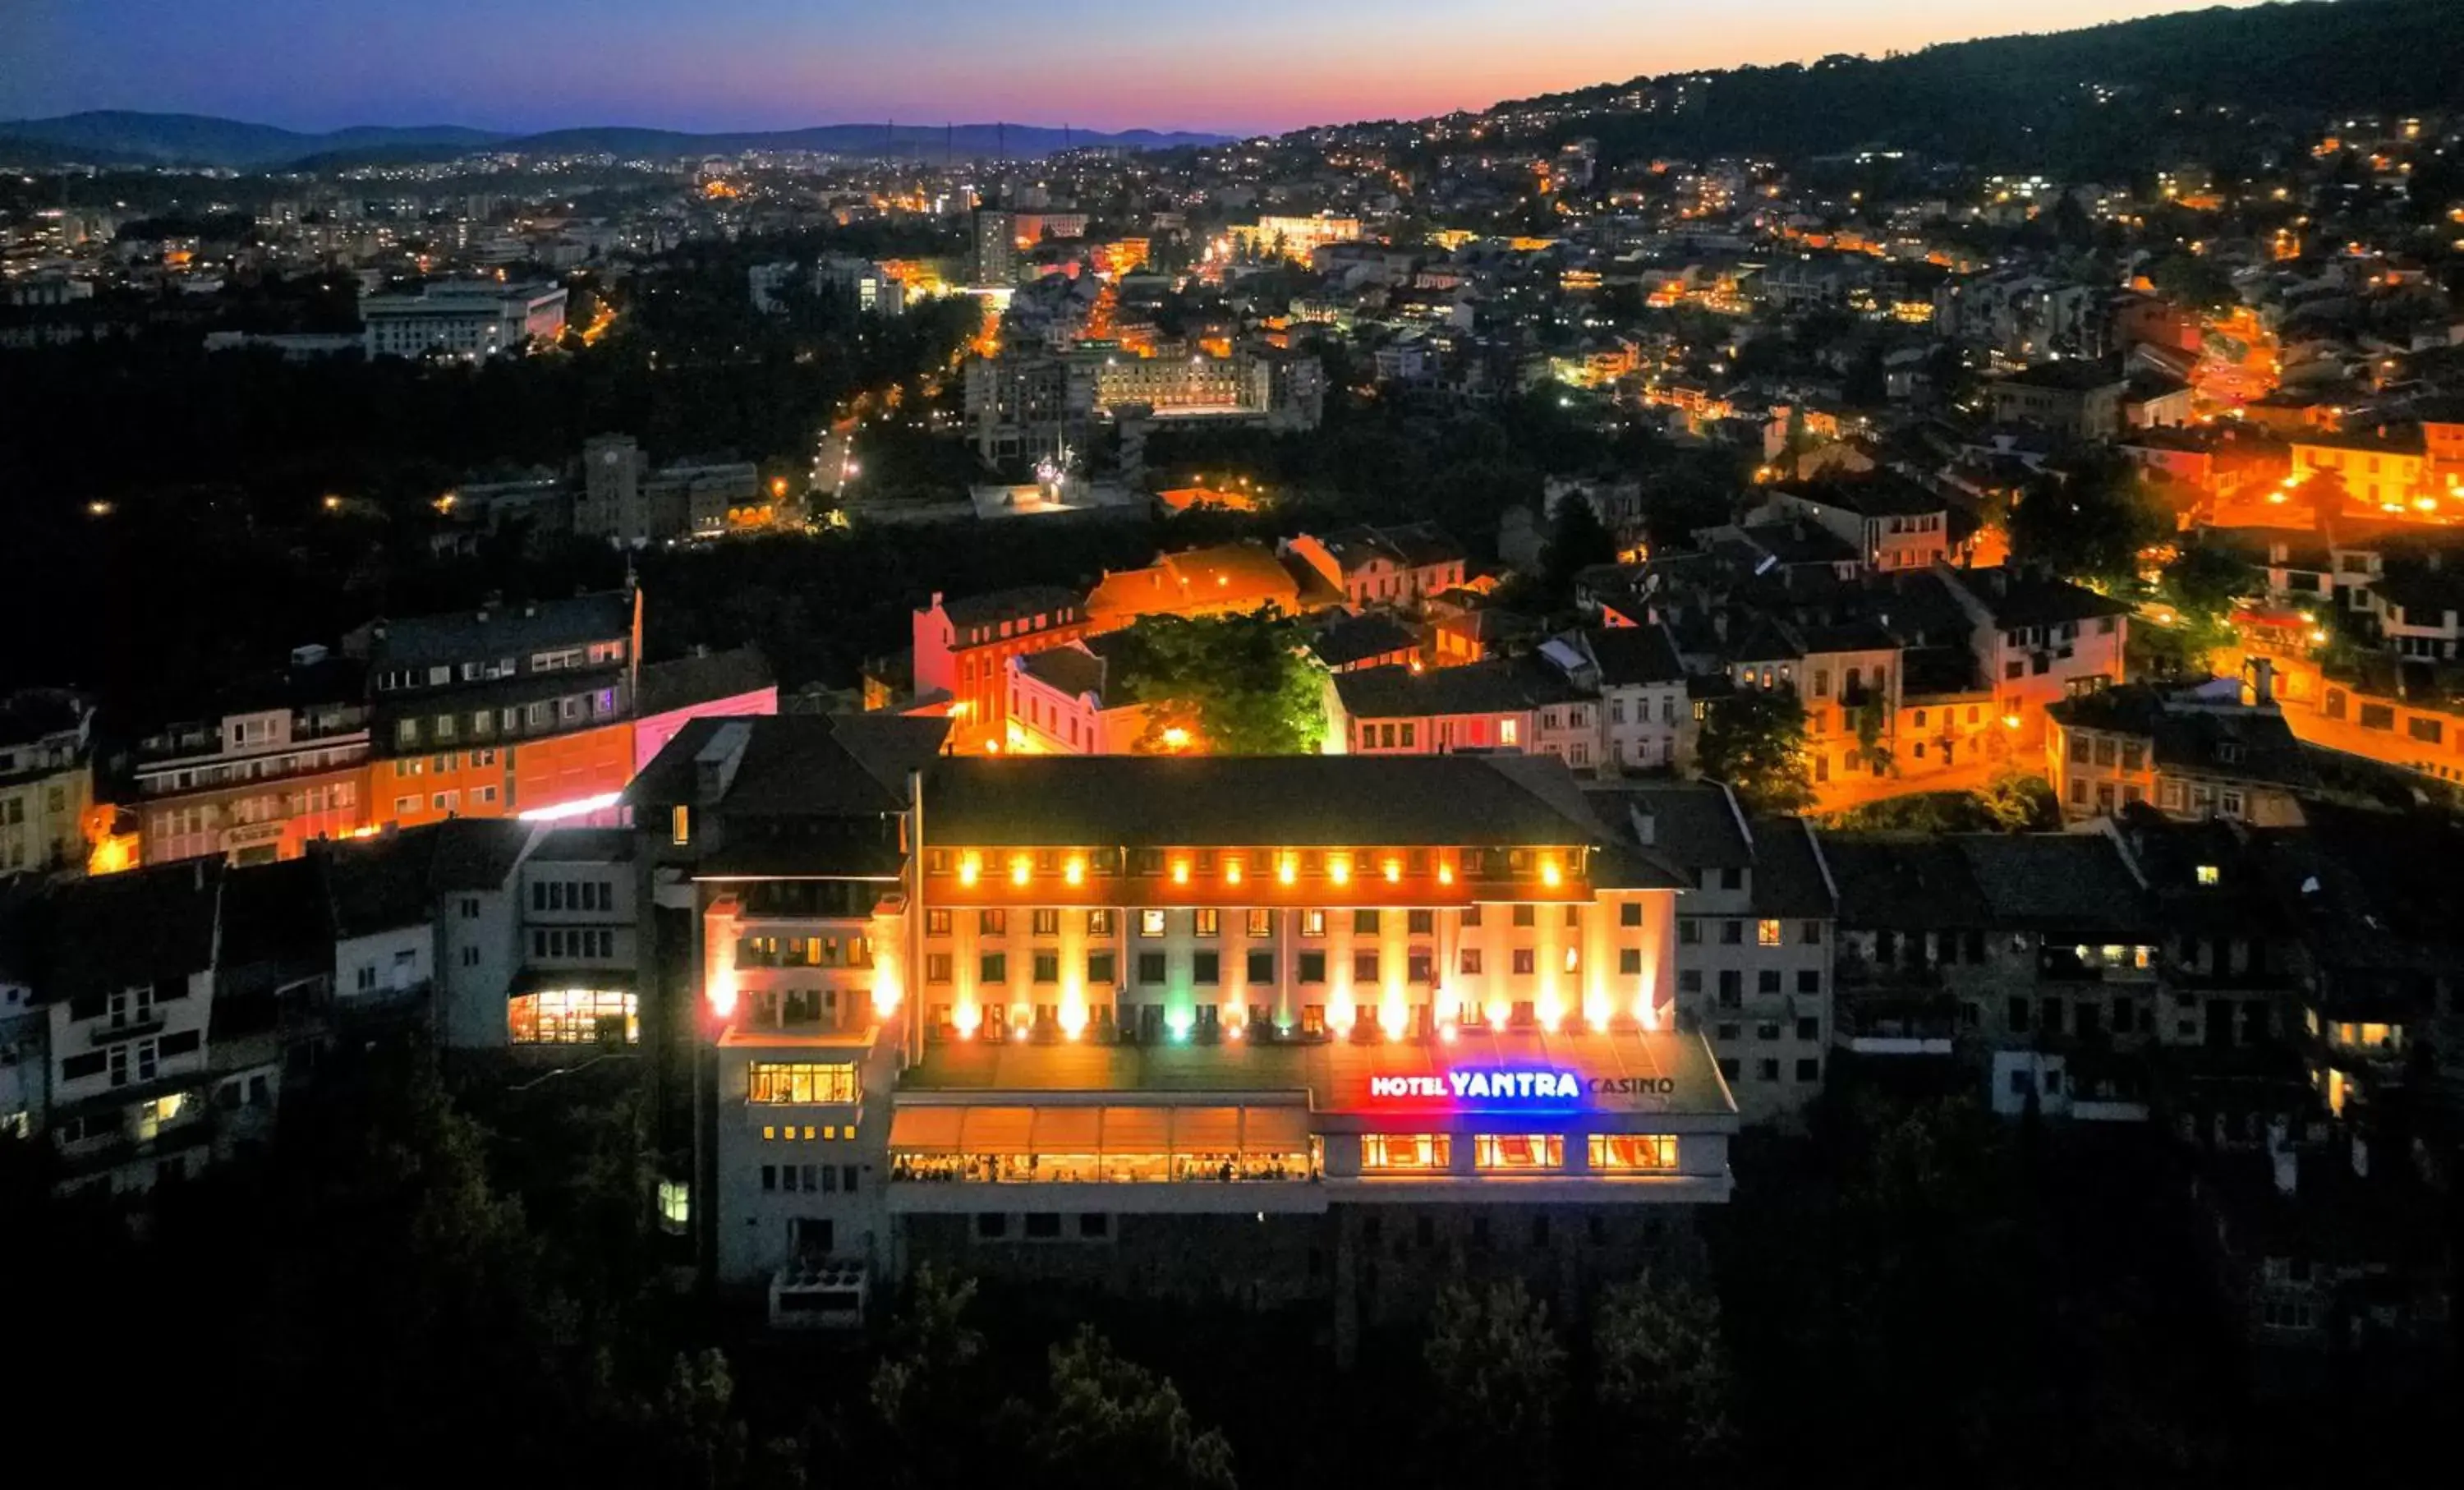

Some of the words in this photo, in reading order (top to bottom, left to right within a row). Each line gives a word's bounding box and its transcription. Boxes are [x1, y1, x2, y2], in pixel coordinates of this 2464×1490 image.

[1372, 1076, 1448, 1097] HOTEL
[1450, 1072, 1579, 1098] YANTRA
[1588, 1077, 1675, 1094] CASINO
